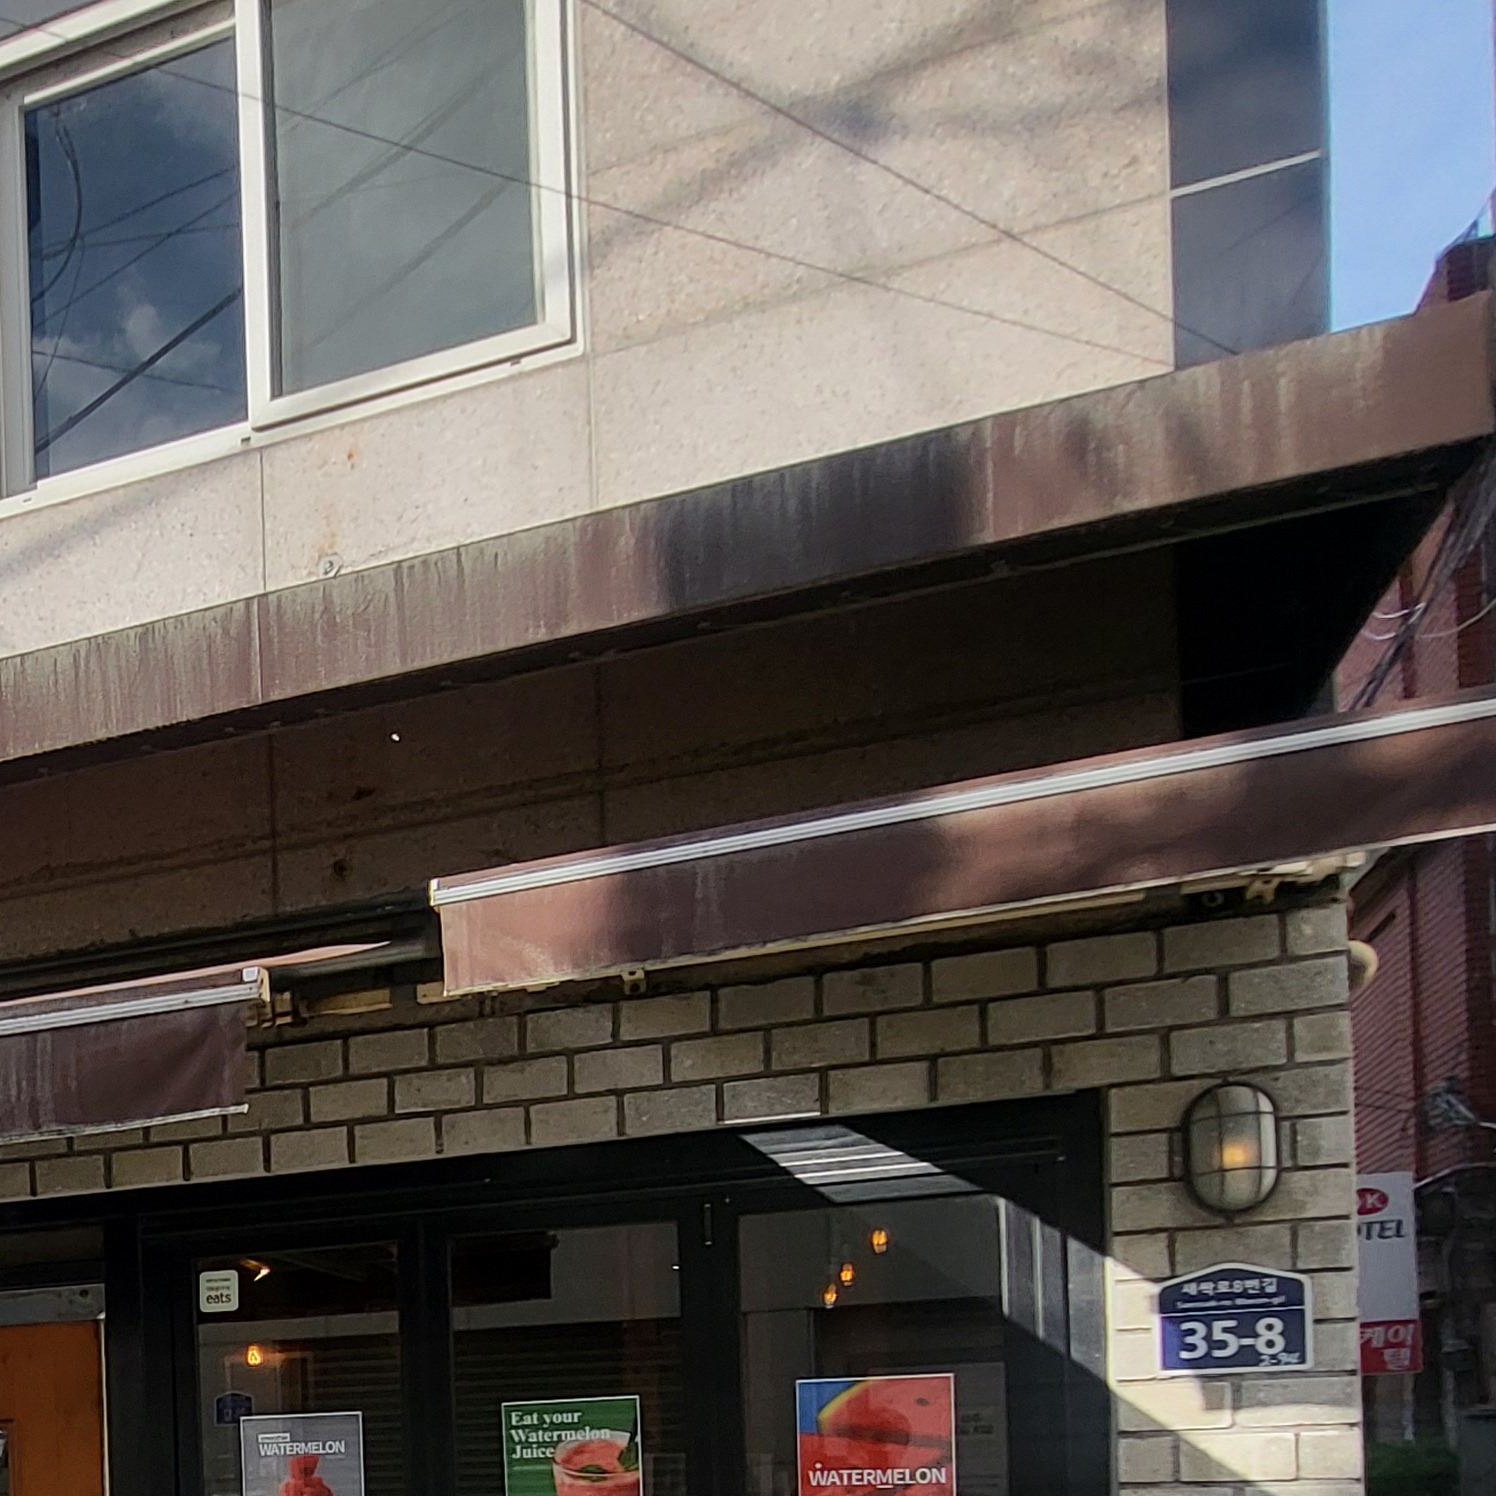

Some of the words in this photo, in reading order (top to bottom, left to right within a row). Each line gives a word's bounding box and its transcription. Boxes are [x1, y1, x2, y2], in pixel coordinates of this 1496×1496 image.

[1357, 1219, 1406, 1240] TEL
[206, 1292, 232, 1304] eats
[1178, 1317, 1286, 1360] 35-8
[510, 1411, 539, 1426] Eat
[542, 1411, 583, 1428] your
[509, 1426, 612, 1443] Watermelon
[259, 1439, 346, 1457] WATERMELON
[511, 1444, 555, 1459] Juice
[808, 1466, 947, 1487] WATERMELON
